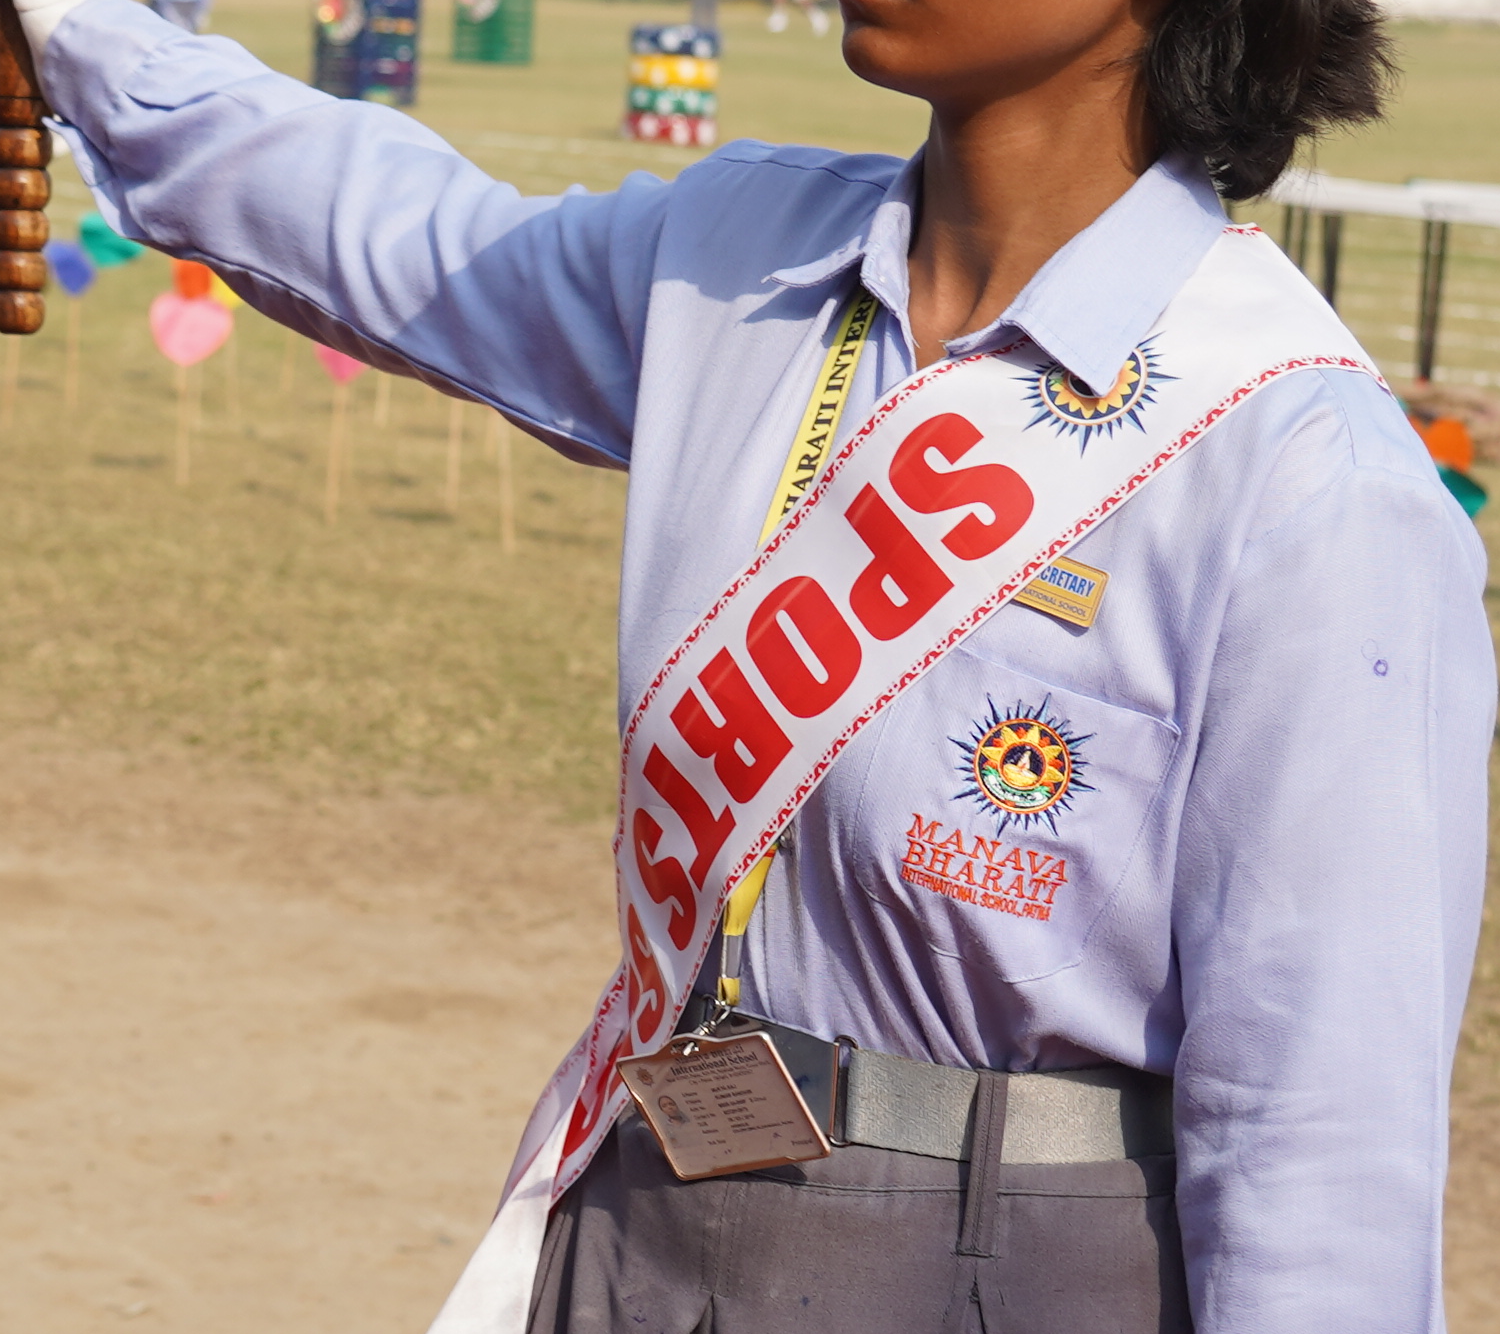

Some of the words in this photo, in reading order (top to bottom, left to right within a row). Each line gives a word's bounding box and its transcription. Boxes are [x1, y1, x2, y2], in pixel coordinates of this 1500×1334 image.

[780, 401, 839, 521] HARATI
[1022, 587, 1057, 606] NATIONAL
[1059, 599, 1087, 617] SCHOOL
[1037, 565, 1097, 597] CRETARY
[631, 412, 1035, 951] SPORTS
[901, 838, 1064, 904] BHARATI
[906, 813, 1068, 883] MANAVA
